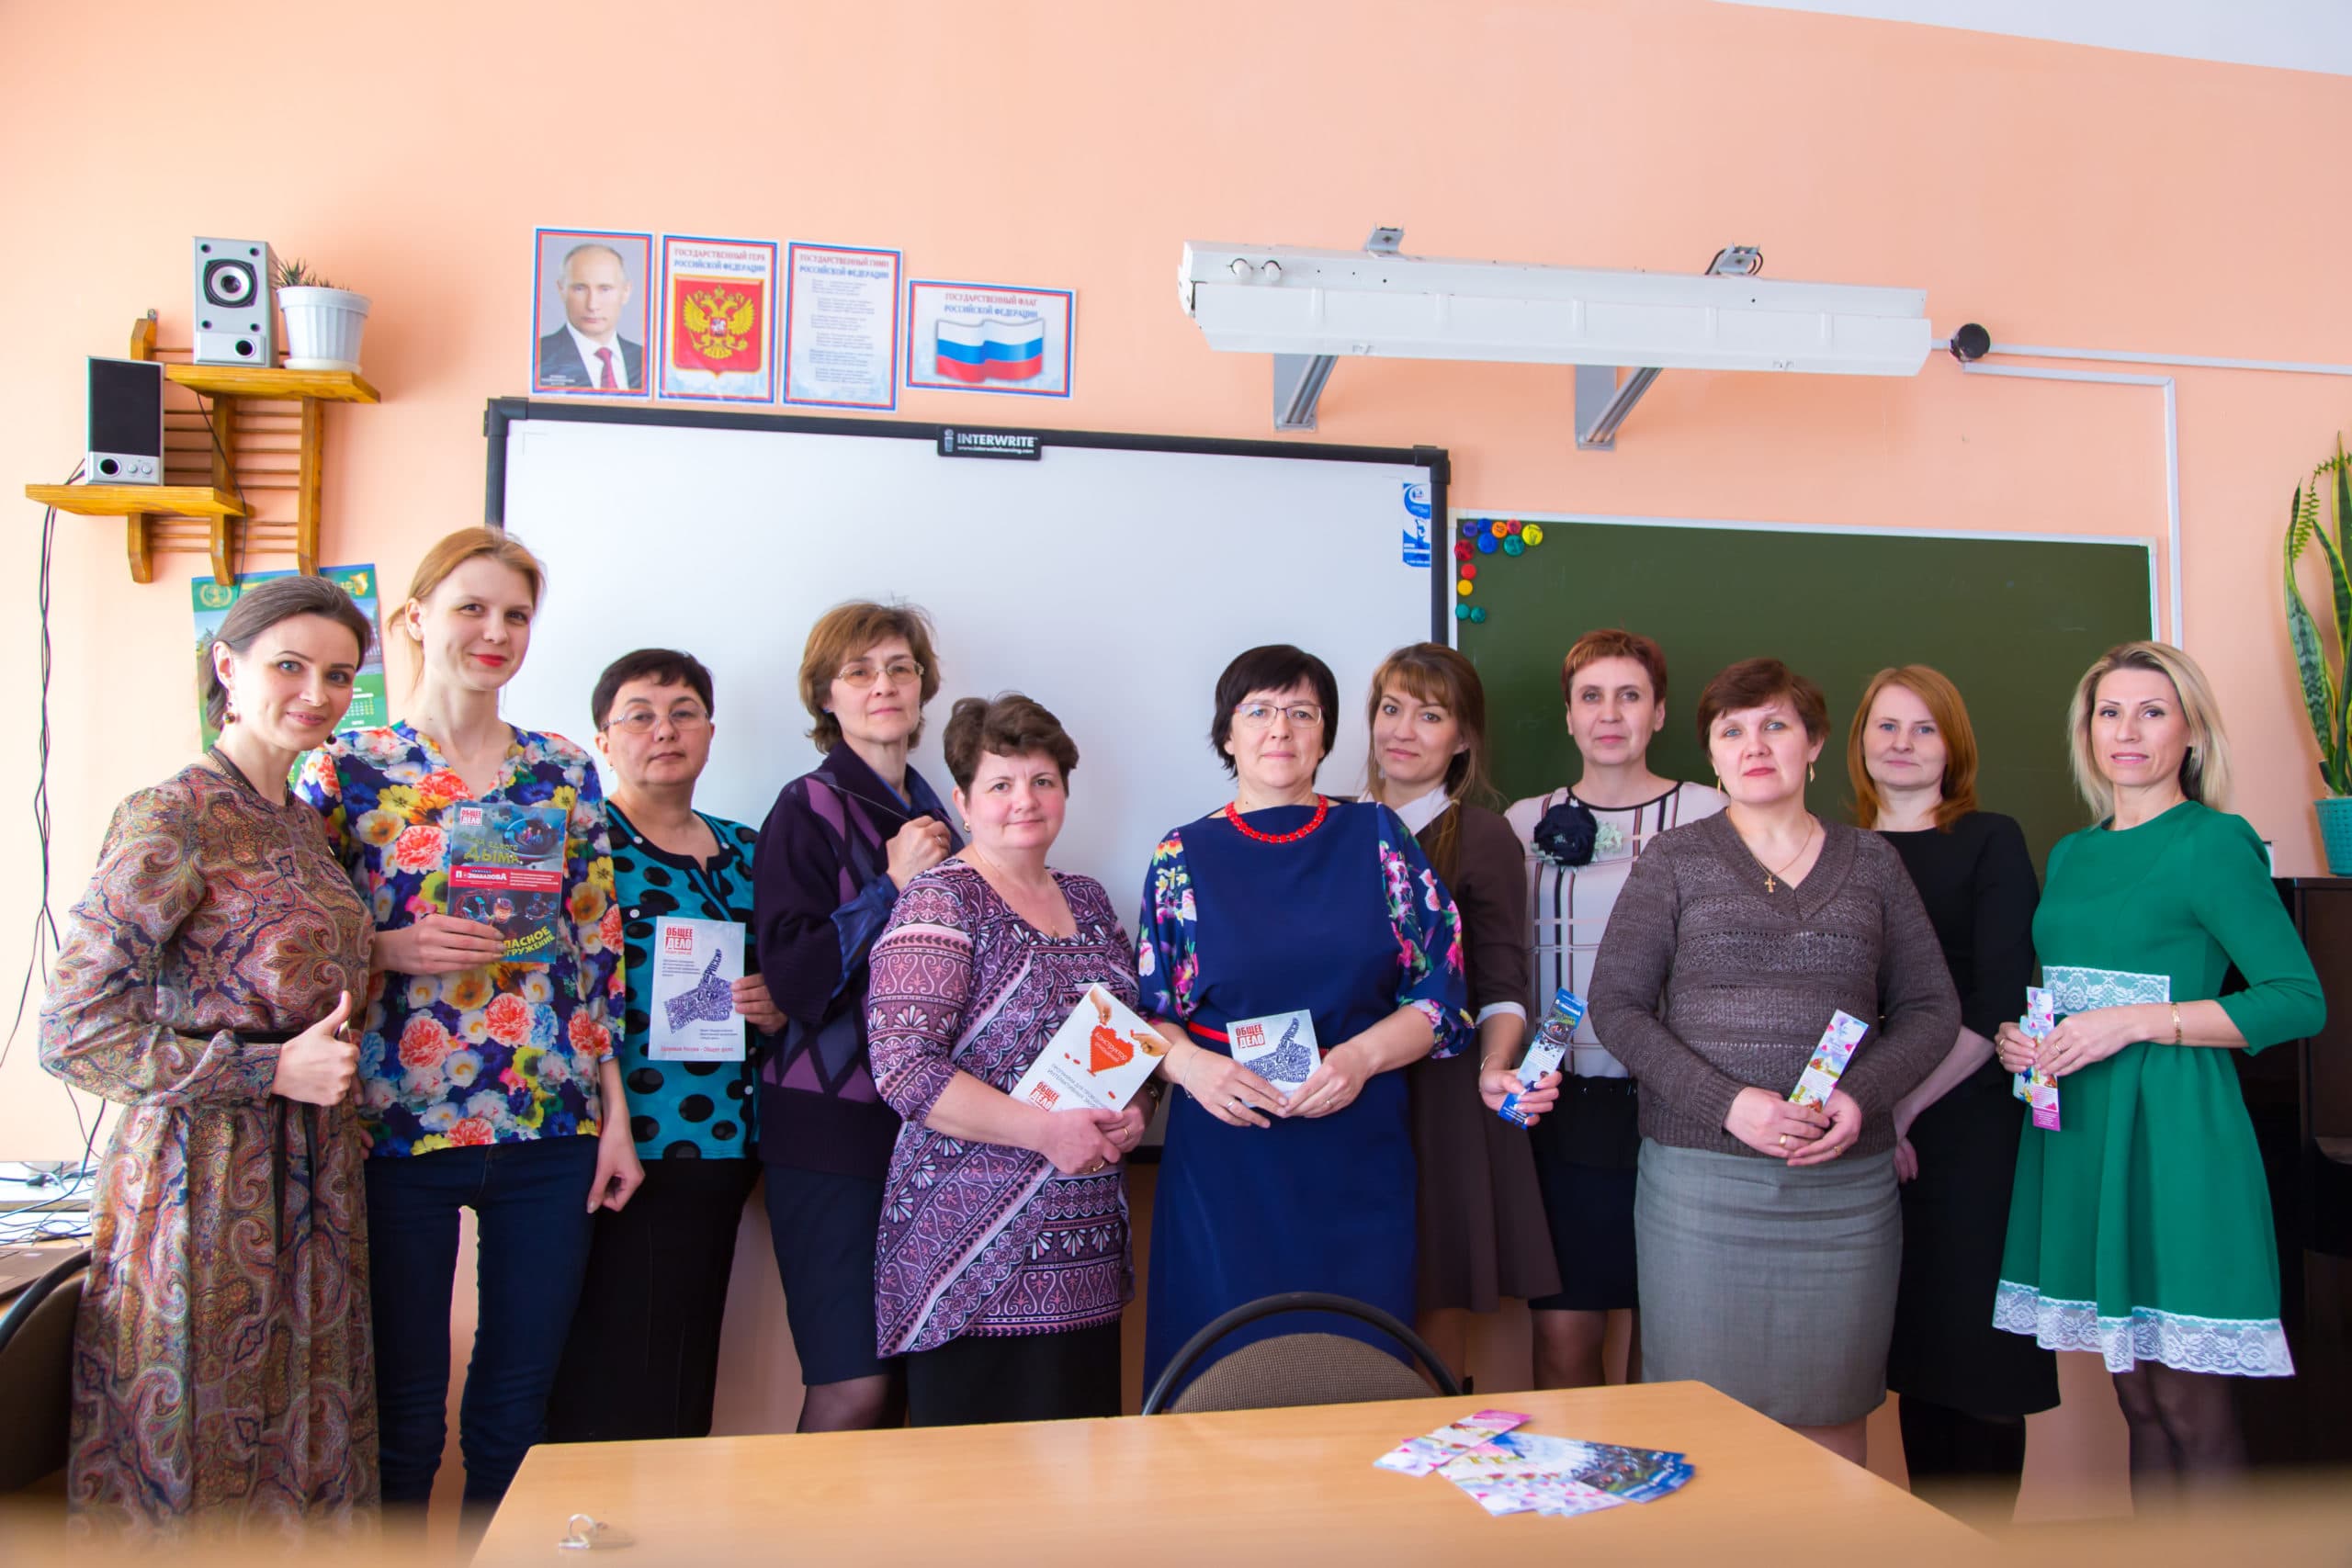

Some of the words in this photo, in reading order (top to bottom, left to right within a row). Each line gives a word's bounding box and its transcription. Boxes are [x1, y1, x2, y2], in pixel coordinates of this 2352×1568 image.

[674, 248, 747, 260] ГОСУДАРСТВЕННЫЙ
[674, 259, 721, 270] РОССИЙСКОЙ
[723, 263, 765, 273] ФЕДЕРАЦИИ
[945, 293, 1016, 305] ГОСУДАРСТВЕННЫЙ
[944, 304, 993, 315] РОССИЙСКОЙ
[994, 308, 1038, 320] ФЕДЕРАЦИИ
[956, 433, 1035, 447] INTERWRITE
[503, 926, 550, 949] ПАСНОЕ
[666, 927, 693, 938] ОБЩЕЕ
[506, 933, 555, 956] ГРУЖЕНИЕ
[666, 937, 693, 950] ДЕЛО
[1236, 1023, 1263, 1037] ОБЩЕЕ
[1238, 1033, 1265, 1049] ДЕЛО
[1036, 1081, 1060, 1102] ОБЩЕЕ
[1029, 1089, 1055, 1111] ДЕЛО
